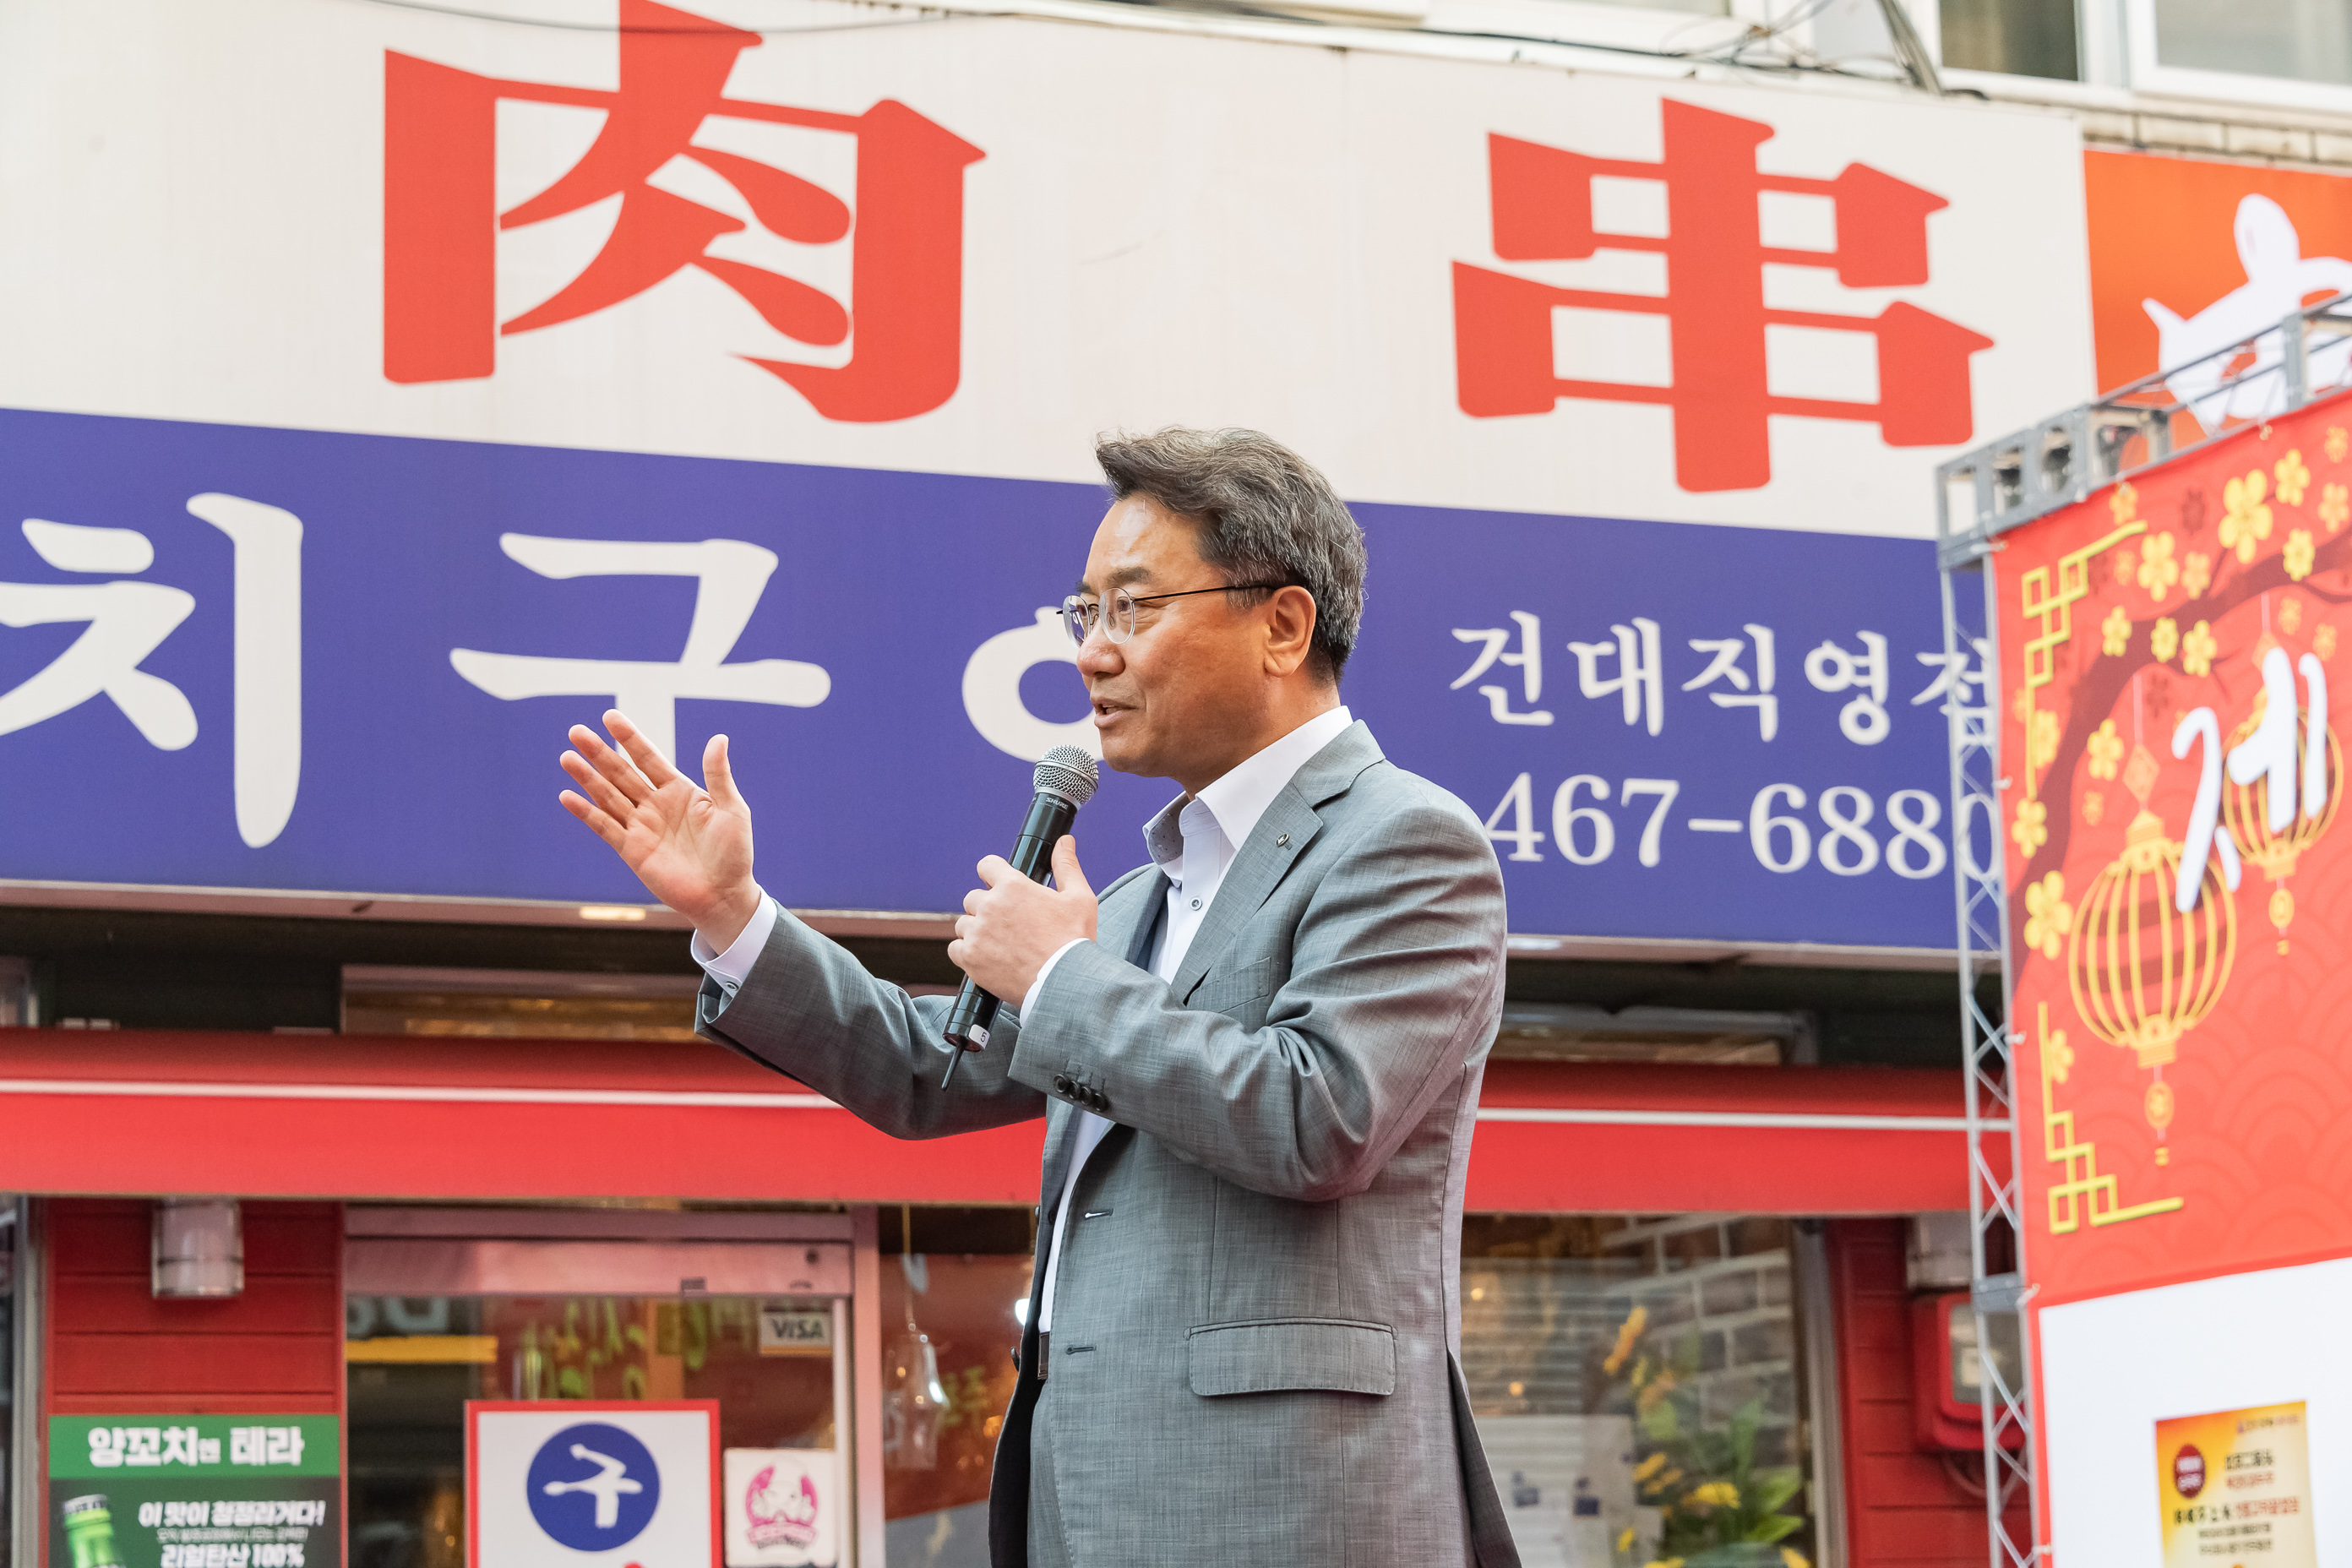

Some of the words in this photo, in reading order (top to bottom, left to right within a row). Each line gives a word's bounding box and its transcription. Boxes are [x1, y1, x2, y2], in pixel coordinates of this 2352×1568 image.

[0, 492, 1098, 848] 치구
[2171, 646, 2328, 912] 제
[1045, 797, 1069, 810] SHURE
[1484, 771, 2004, 880] 467-6880
[772, 1319, 823, 1339] VISA
[230, 1426, 306, 1467] 테라
[252, 1543, 305, 1568] 100%
